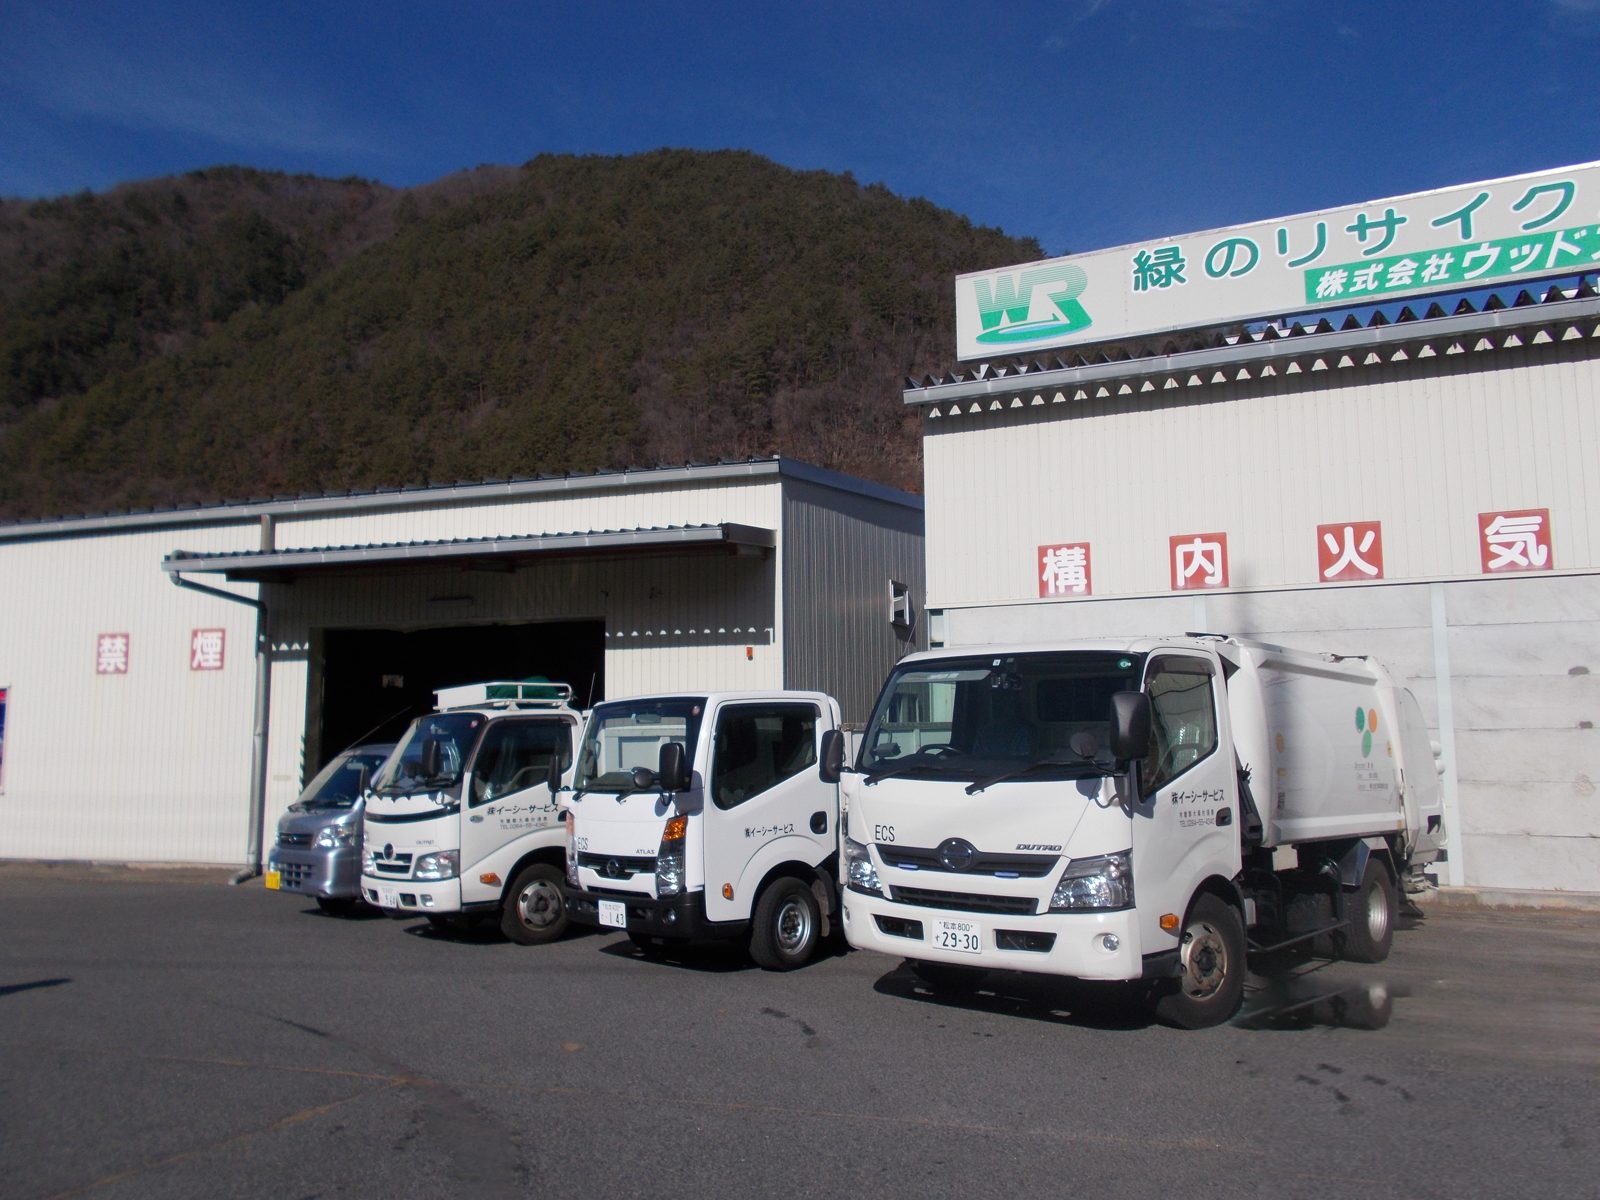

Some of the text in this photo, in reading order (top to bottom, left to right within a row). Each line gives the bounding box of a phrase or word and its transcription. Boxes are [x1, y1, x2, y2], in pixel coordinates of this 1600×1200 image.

[1315, 229, 1600, 299] 株式会社ウッド
[875, 824, 896, 842] ECS
[1016, 843, 1062, 852] DUTRO
